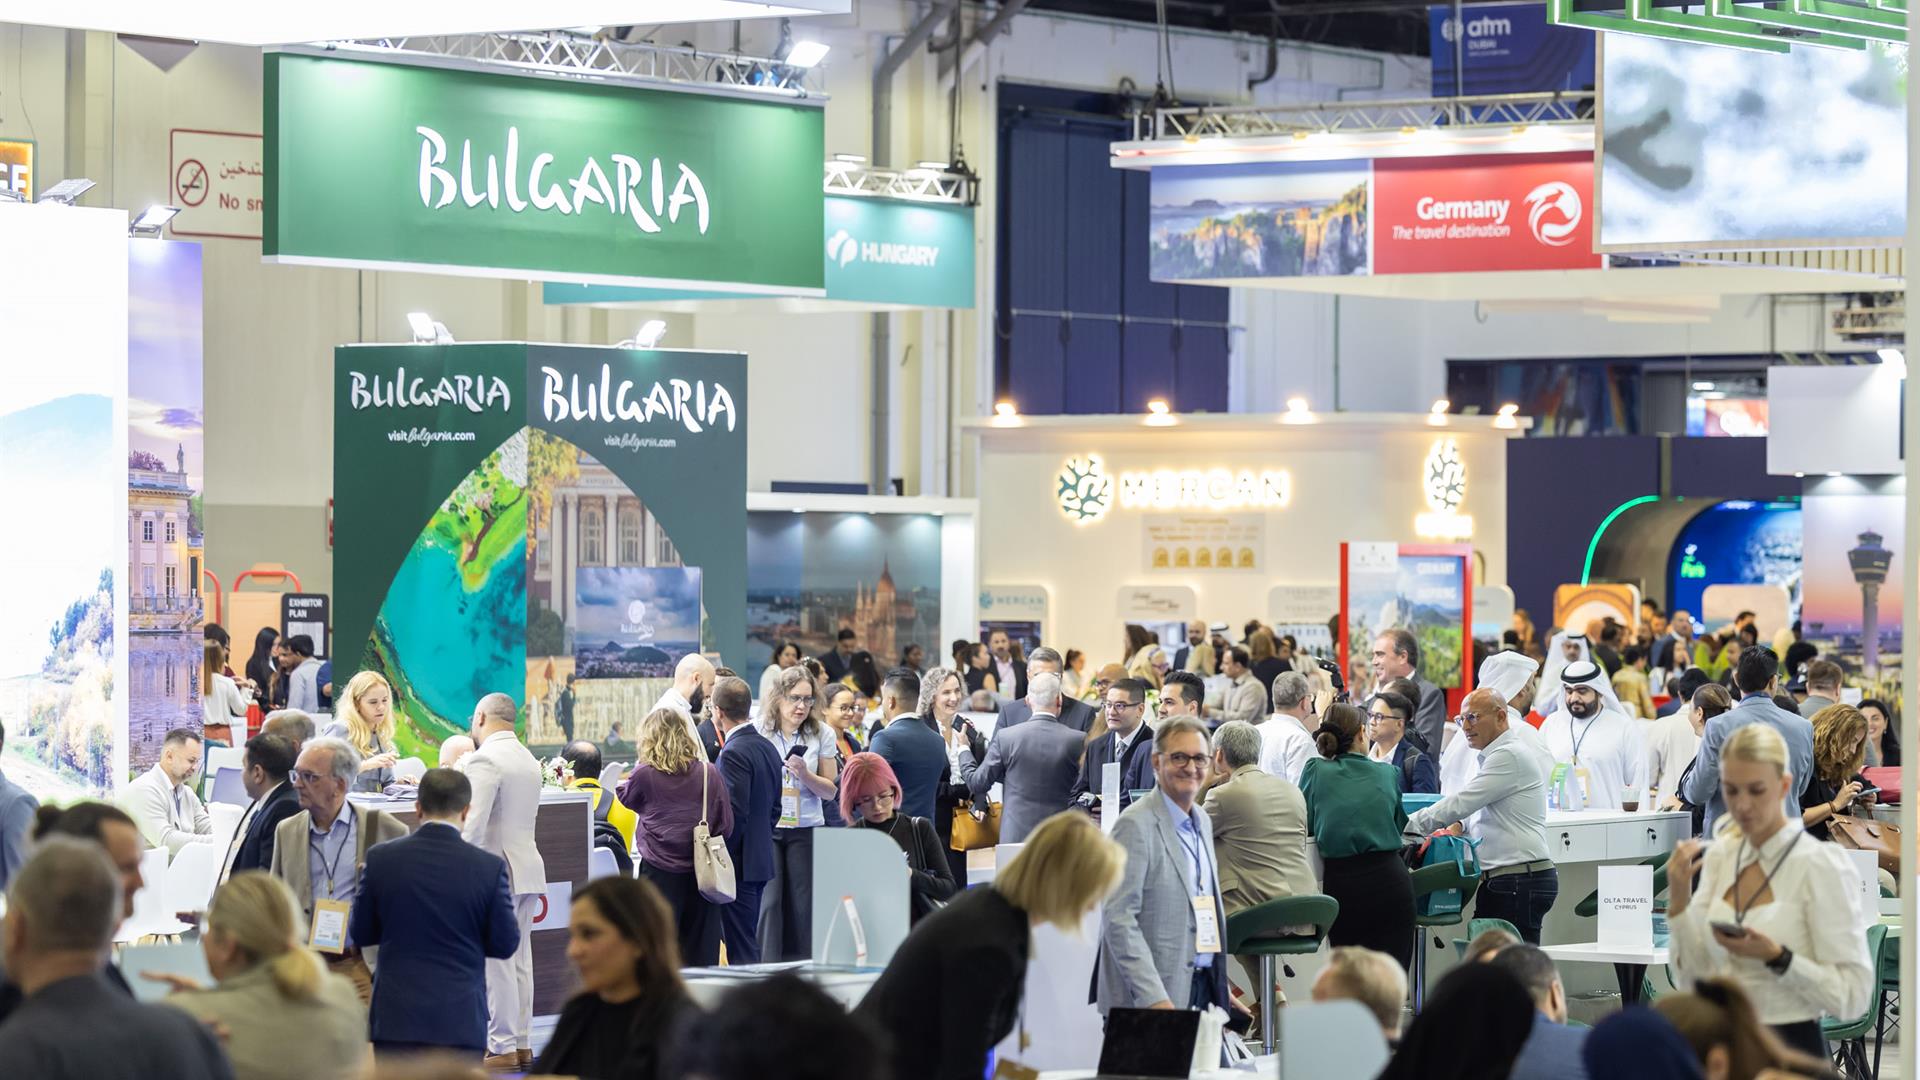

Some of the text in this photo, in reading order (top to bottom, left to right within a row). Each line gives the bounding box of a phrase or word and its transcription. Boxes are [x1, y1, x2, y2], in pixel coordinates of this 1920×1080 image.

[1466, 15, 1512, 37] atm
[416, 126, 710, 235] BULGARIA
[219, 193, 240, 210] No
[1416, 196, 1510, 224] Germany
[1393, 223, 1511, 240] The travel destination
[861, 241, 940, 268] HUNGARY
[349, 366, 511, 413] BULGARIA
[541, 363, 736, 434] BULGARIA
[1121, 473, 1289, 506] MERCAN
[289, 598, 323, 608] EXHIBITOR
[289, 608, 307, 618] PLAN
